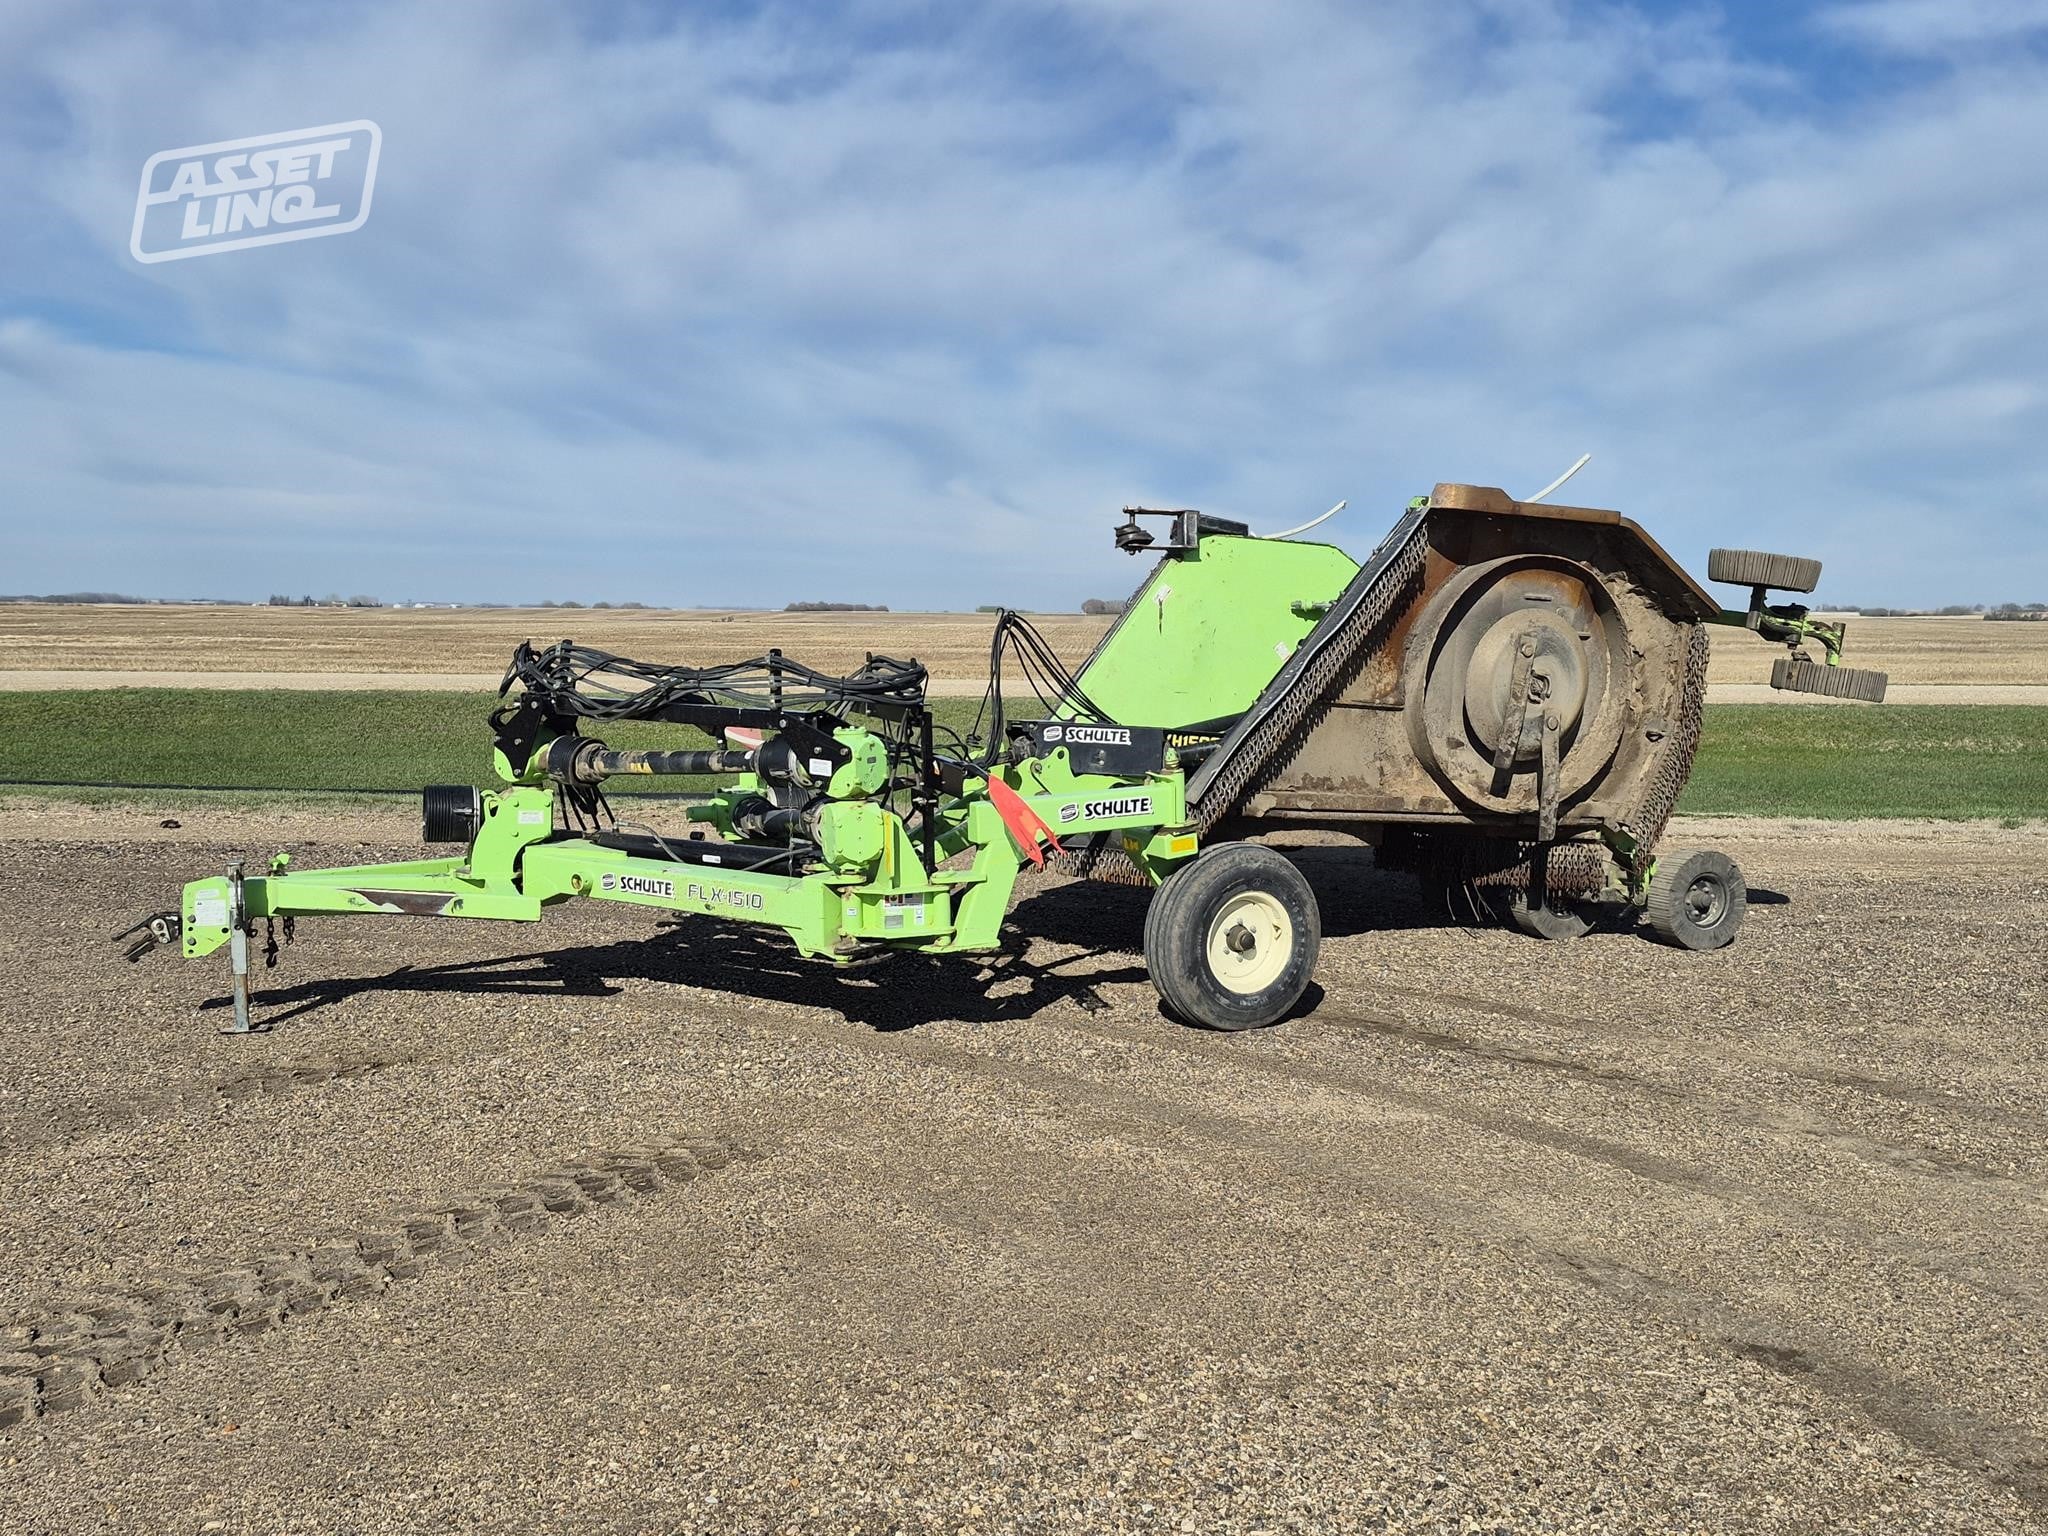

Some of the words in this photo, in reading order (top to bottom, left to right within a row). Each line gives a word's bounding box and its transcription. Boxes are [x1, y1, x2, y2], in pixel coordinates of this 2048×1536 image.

[1066, 728, 1130, 743] SCHULTE
[1084, 797, 1150, 818] SCHULTE
[620, 876, 673, 896] SCHULTE
